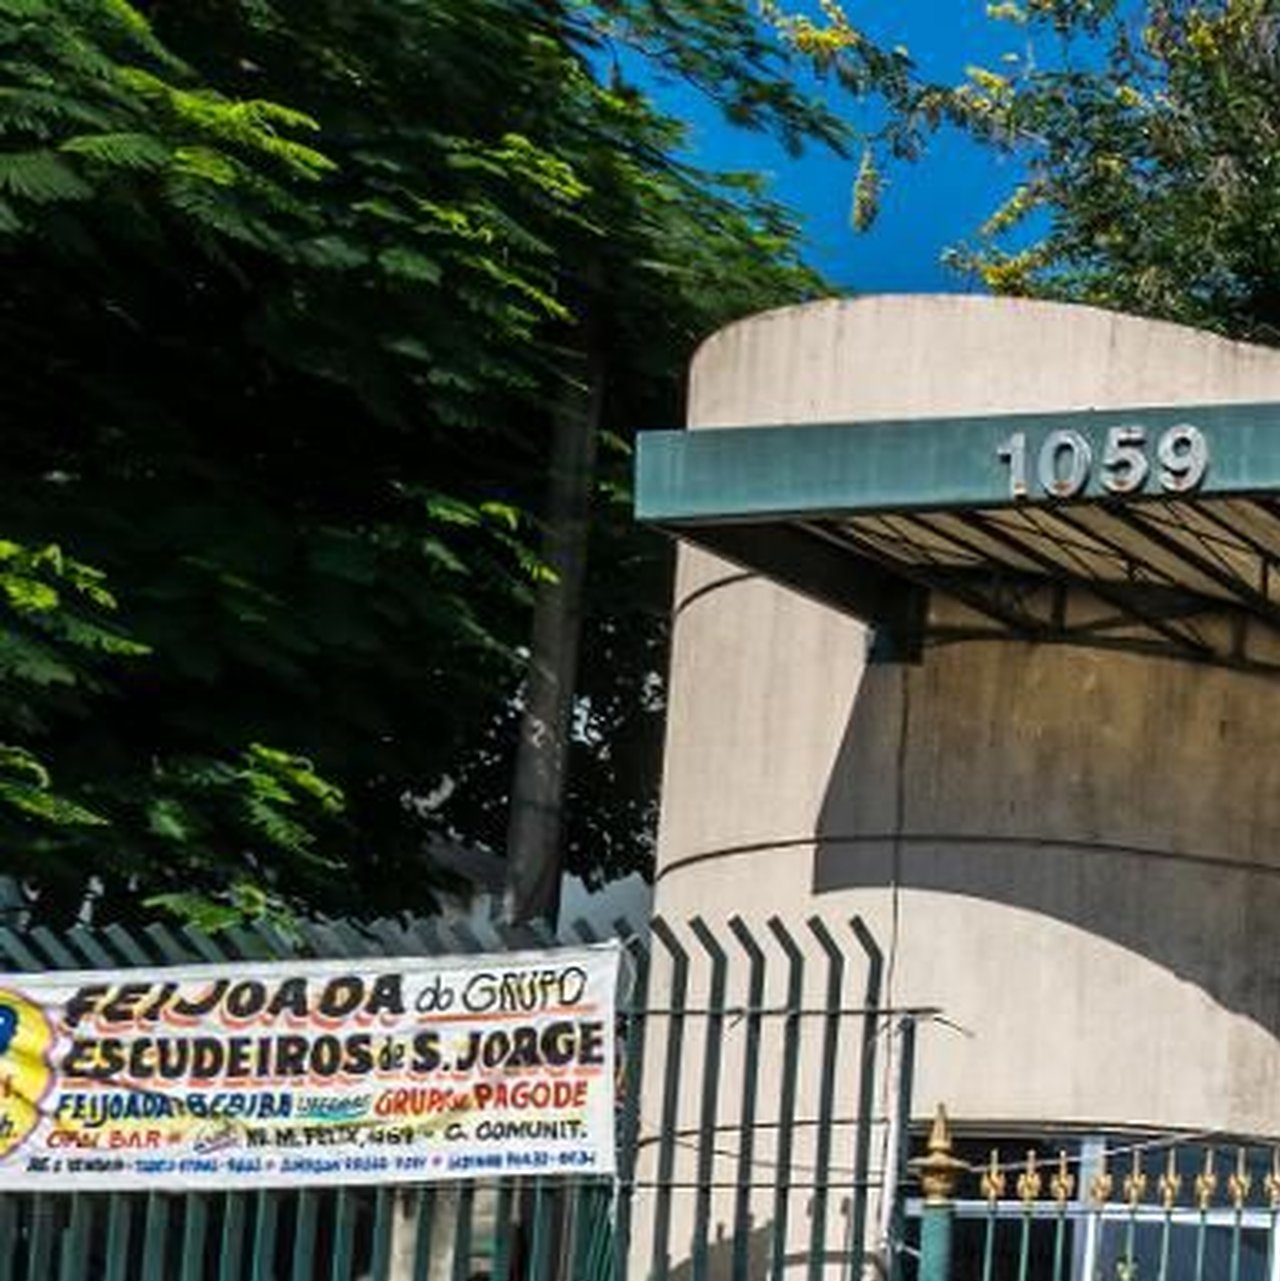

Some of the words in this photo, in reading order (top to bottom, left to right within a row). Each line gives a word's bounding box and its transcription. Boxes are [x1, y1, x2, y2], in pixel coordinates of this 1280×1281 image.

[997, 424, 1208, 498] 1059
[63, 974, 404, 1028] FEIJOADA
[416, 975, 454, 1012] do
[462, 966, 588, 1012] GRUPO
[62, 1033, 373, 1078] ESCUDEIROS
[376, 1036, 404, 1071] de
[53, 1091, 175, 1128] FEIJOADA
[474, 1080, 588, 1111] PAGODE
[108, 1130, 162, 1148] BAR
